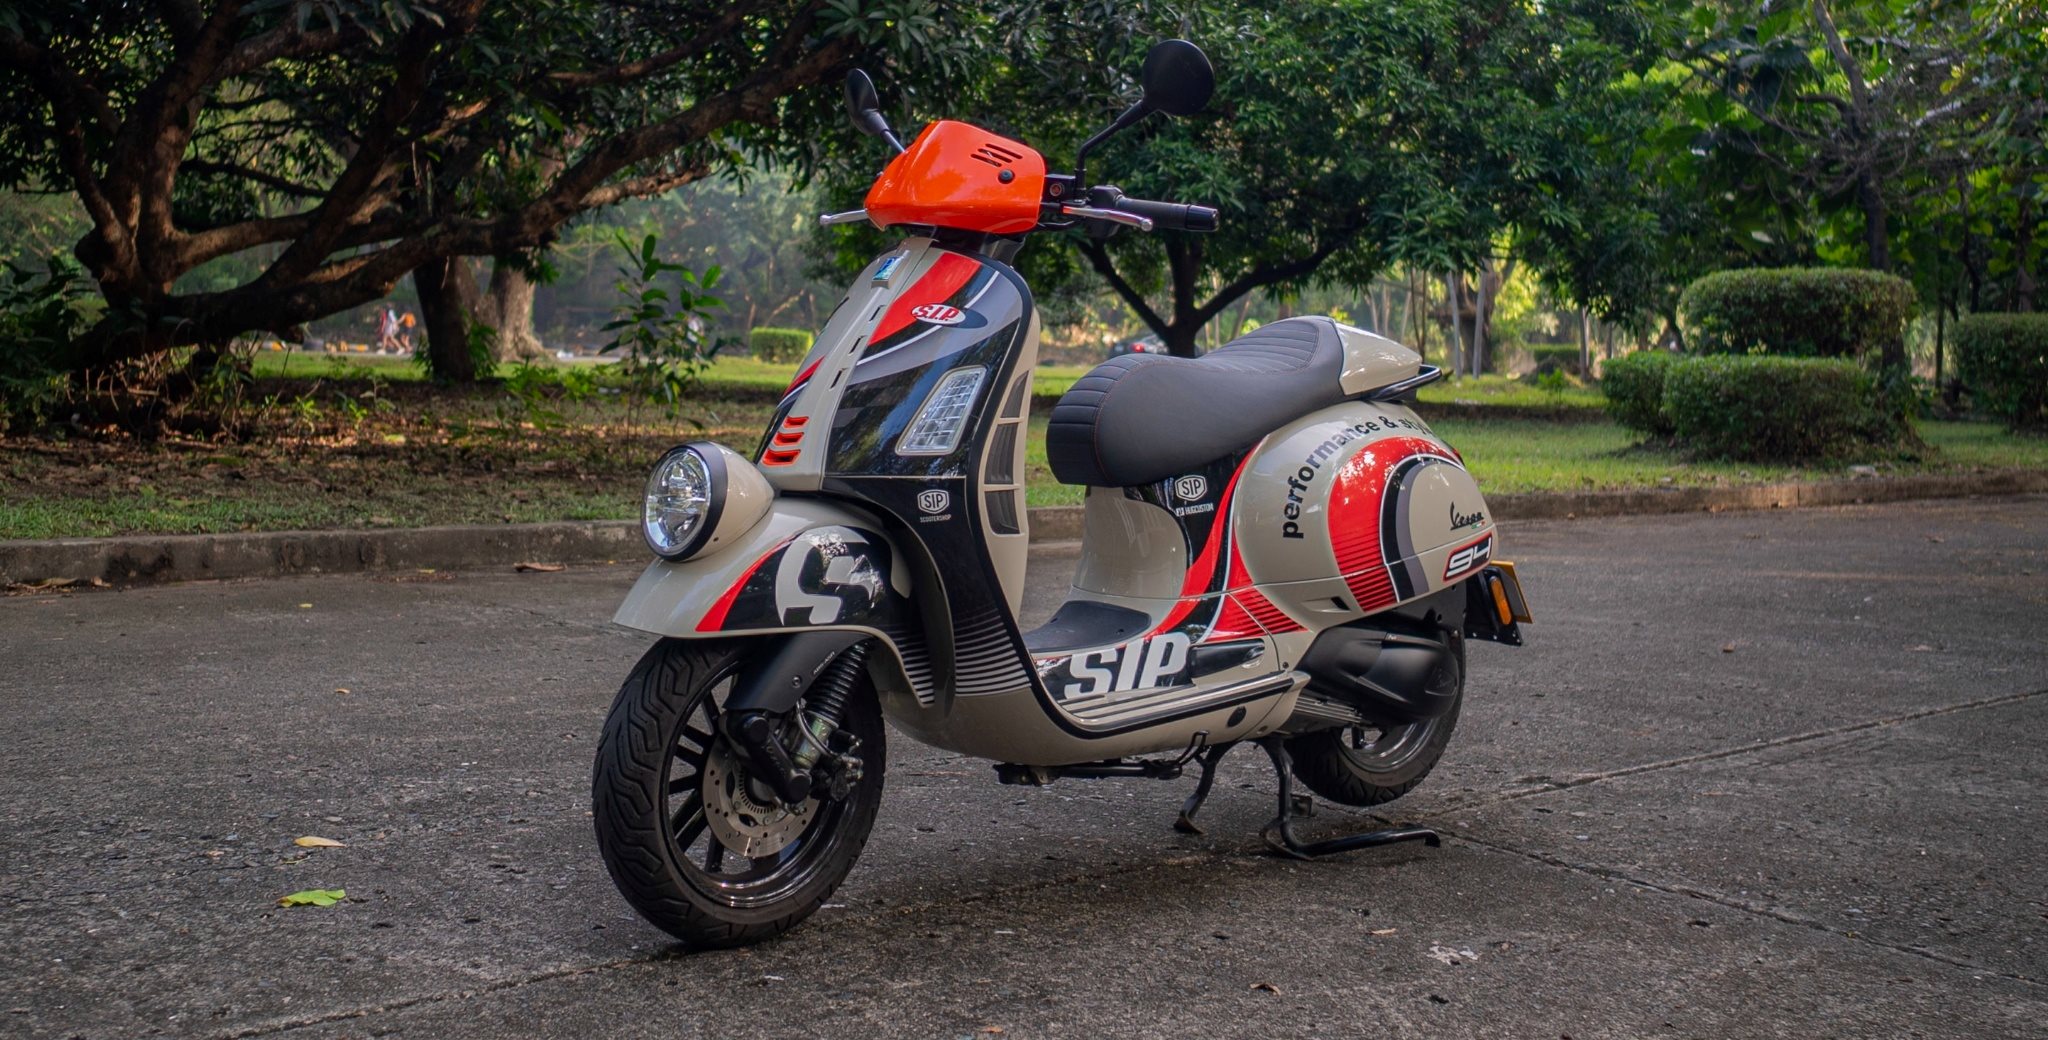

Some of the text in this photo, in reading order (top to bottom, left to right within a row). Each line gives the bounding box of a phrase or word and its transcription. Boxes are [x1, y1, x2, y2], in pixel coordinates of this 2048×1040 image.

[1181, 479, 1201, 496] SIP
[1283, 421, 1380, 539] performance
[1378, 415, 1400, 429] &
[924, 493, 944, 509] SIP
[1449, 501, 1484, 531] Vespa
[1064, 631, 1191, 700] SIP
